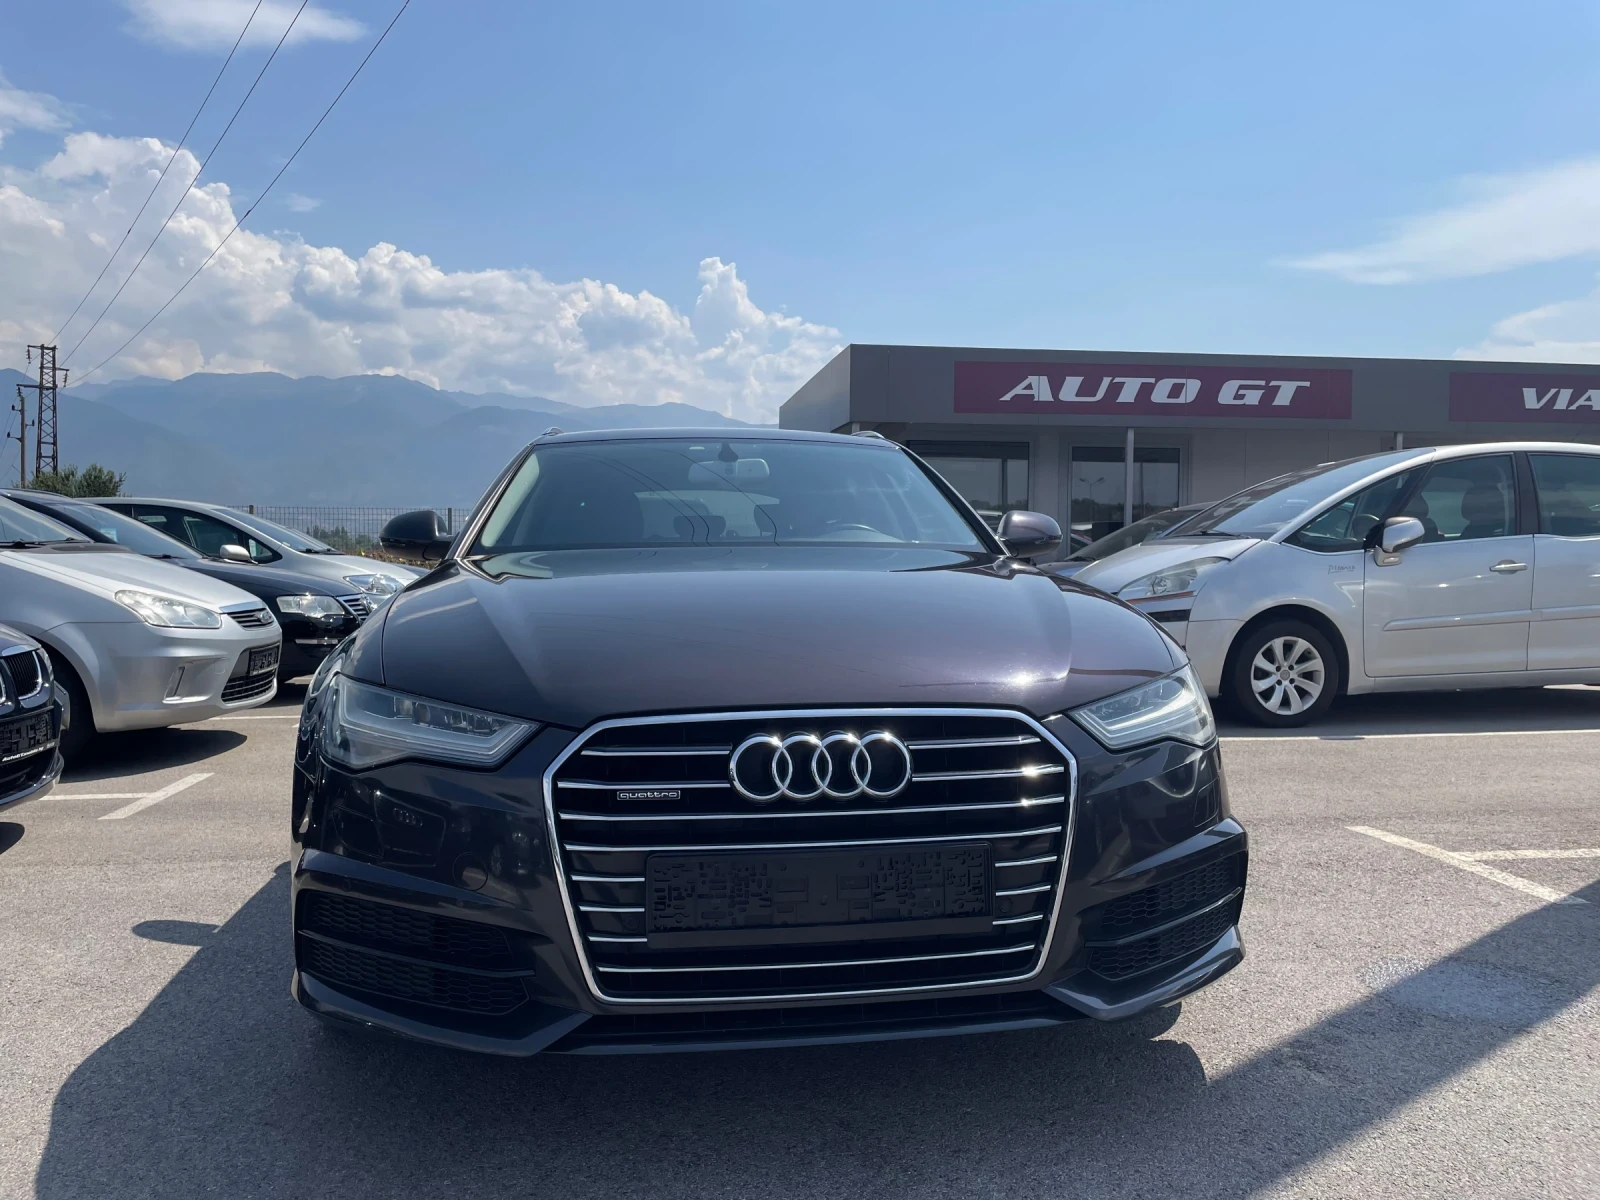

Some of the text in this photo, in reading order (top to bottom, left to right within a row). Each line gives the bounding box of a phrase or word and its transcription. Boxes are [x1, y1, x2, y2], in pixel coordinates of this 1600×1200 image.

[998, 375, 1311, 406] AUTO GT
[619, 791, 679, 800] quattro
